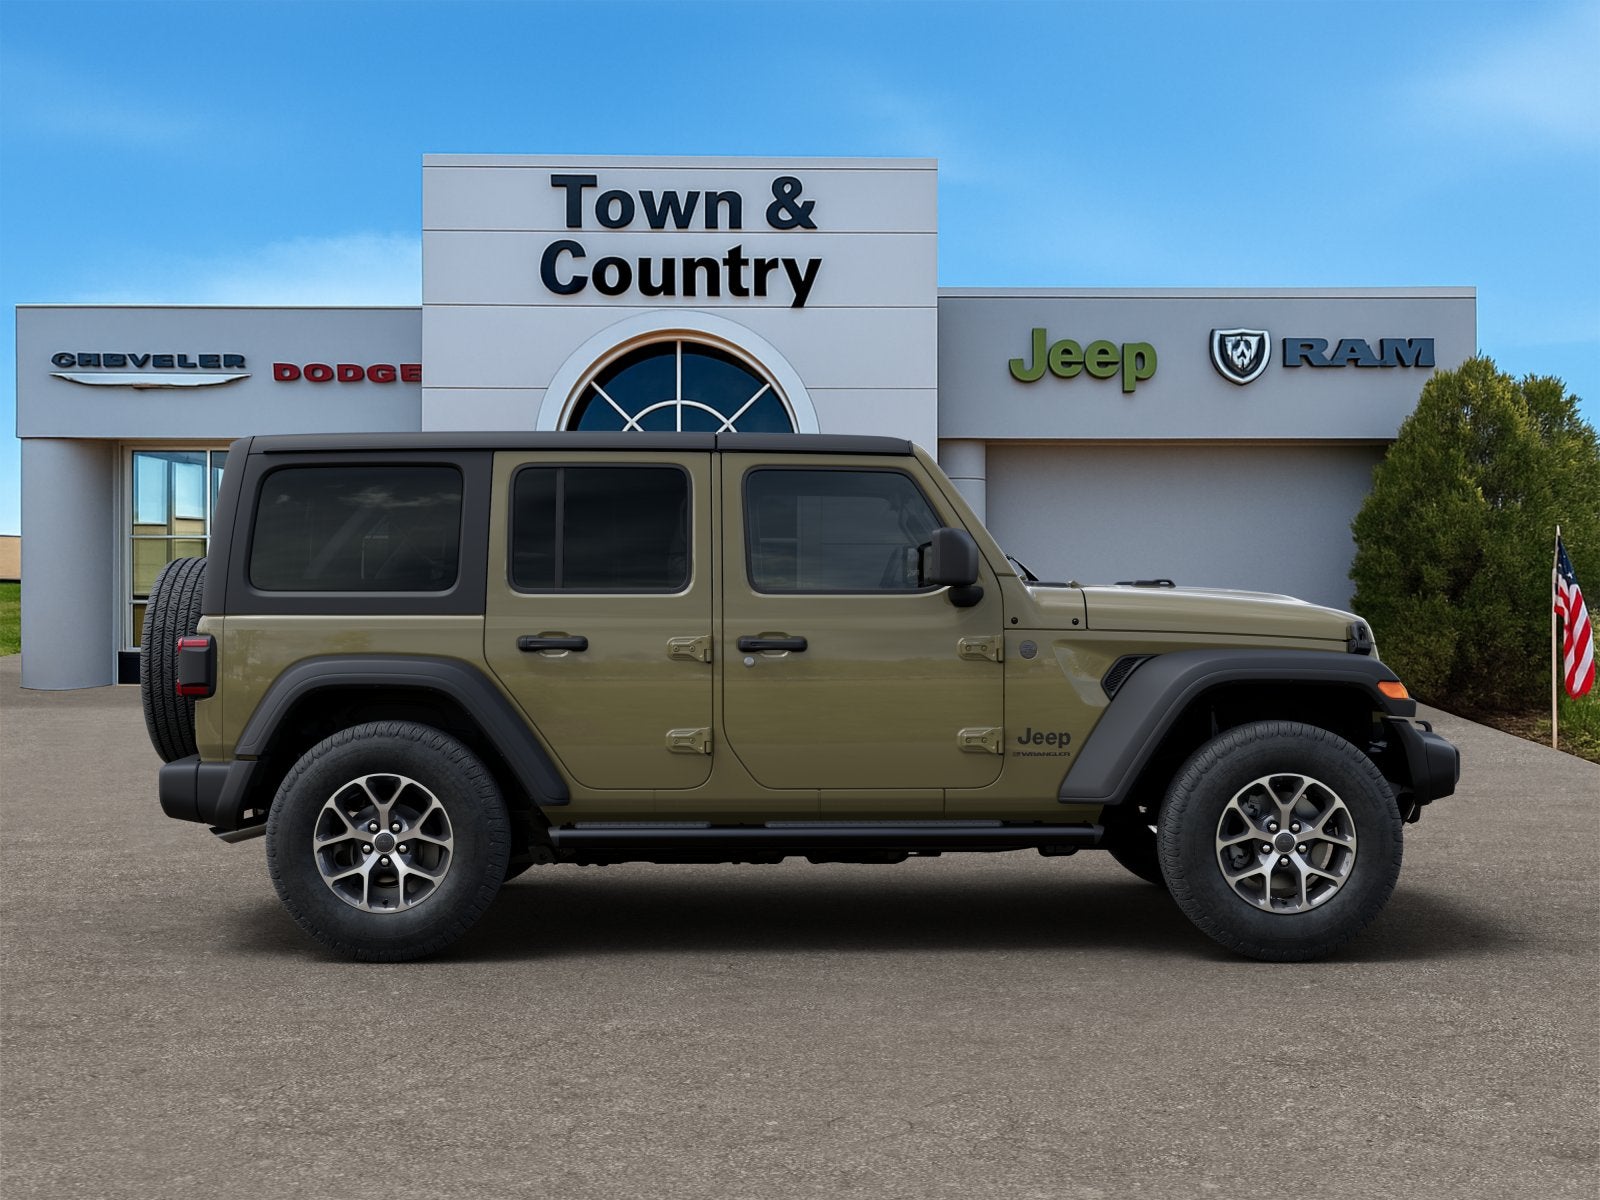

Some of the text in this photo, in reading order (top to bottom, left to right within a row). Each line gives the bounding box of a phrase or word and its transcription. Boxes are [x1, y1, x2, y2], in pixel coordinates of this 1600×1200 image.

[551, 174, 818, 229] Town &
[540, 239, 822, 308] Country
[272, 362, 422, 383] DODGE
[1008, 328, 1158, 393] Jeep
[1283, 337, 1435, 368] RAM
[1017, 728, 1071, 748] Jeep
